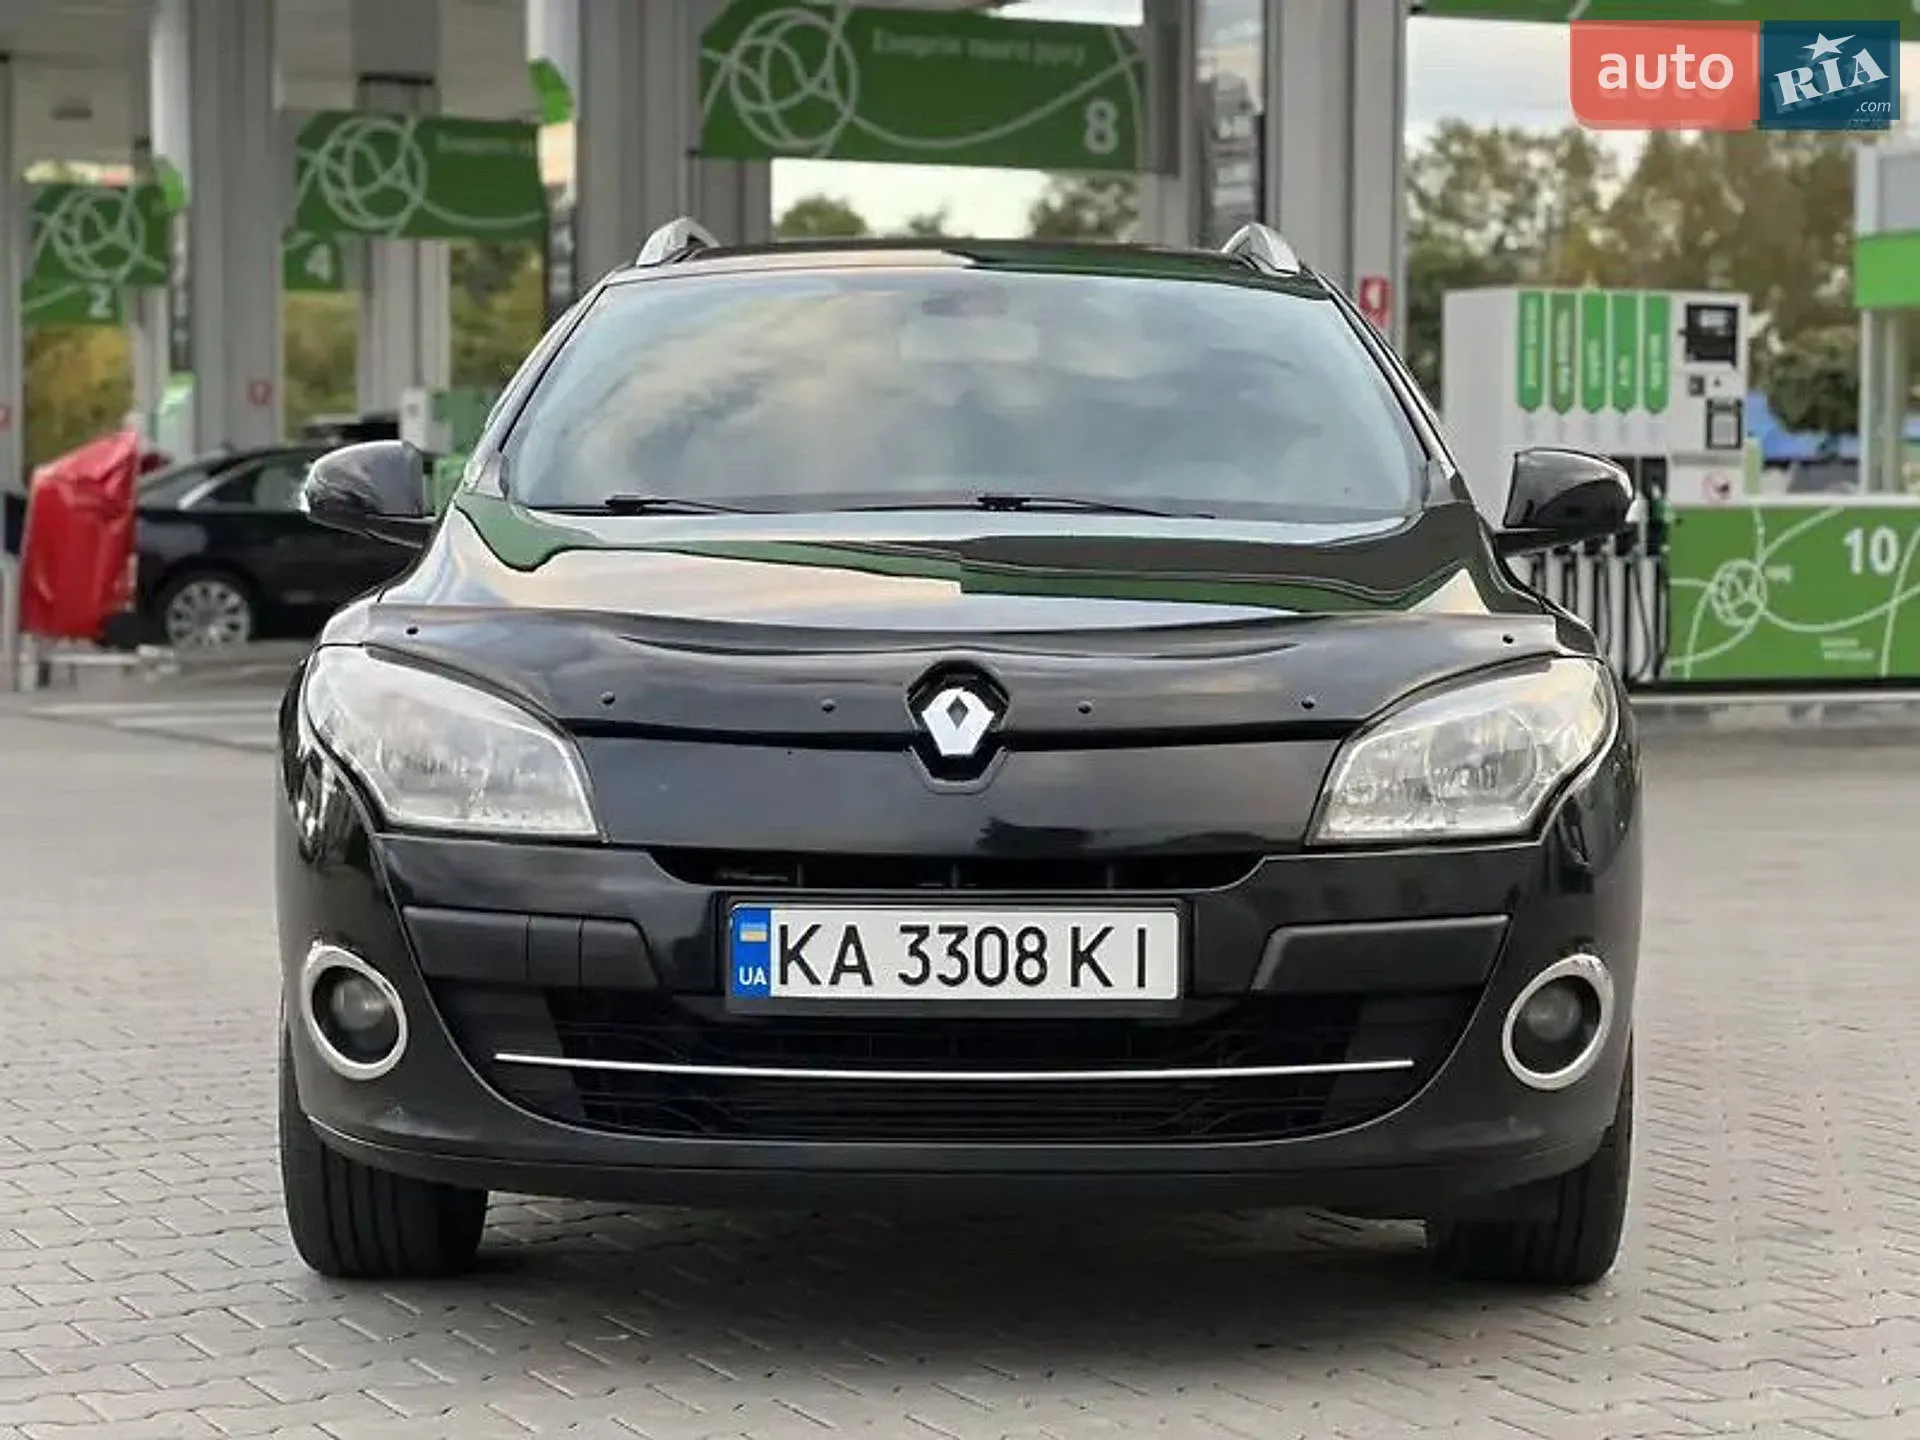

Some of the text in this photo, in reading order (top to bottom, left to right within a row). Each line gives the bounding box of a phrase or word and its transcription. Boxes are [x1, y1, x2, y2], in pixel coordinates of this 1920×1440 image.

[1085, 98, 1117, 153] 8
[305, 244, 332, 281] 4
[86, 284, 112, 317] 2
[1843, 526, 1900, 575] 10
[737, 966, 768, 986] UA
[778, 924, 872, 986] KA
[898, 926, 1048, 986] 3308
